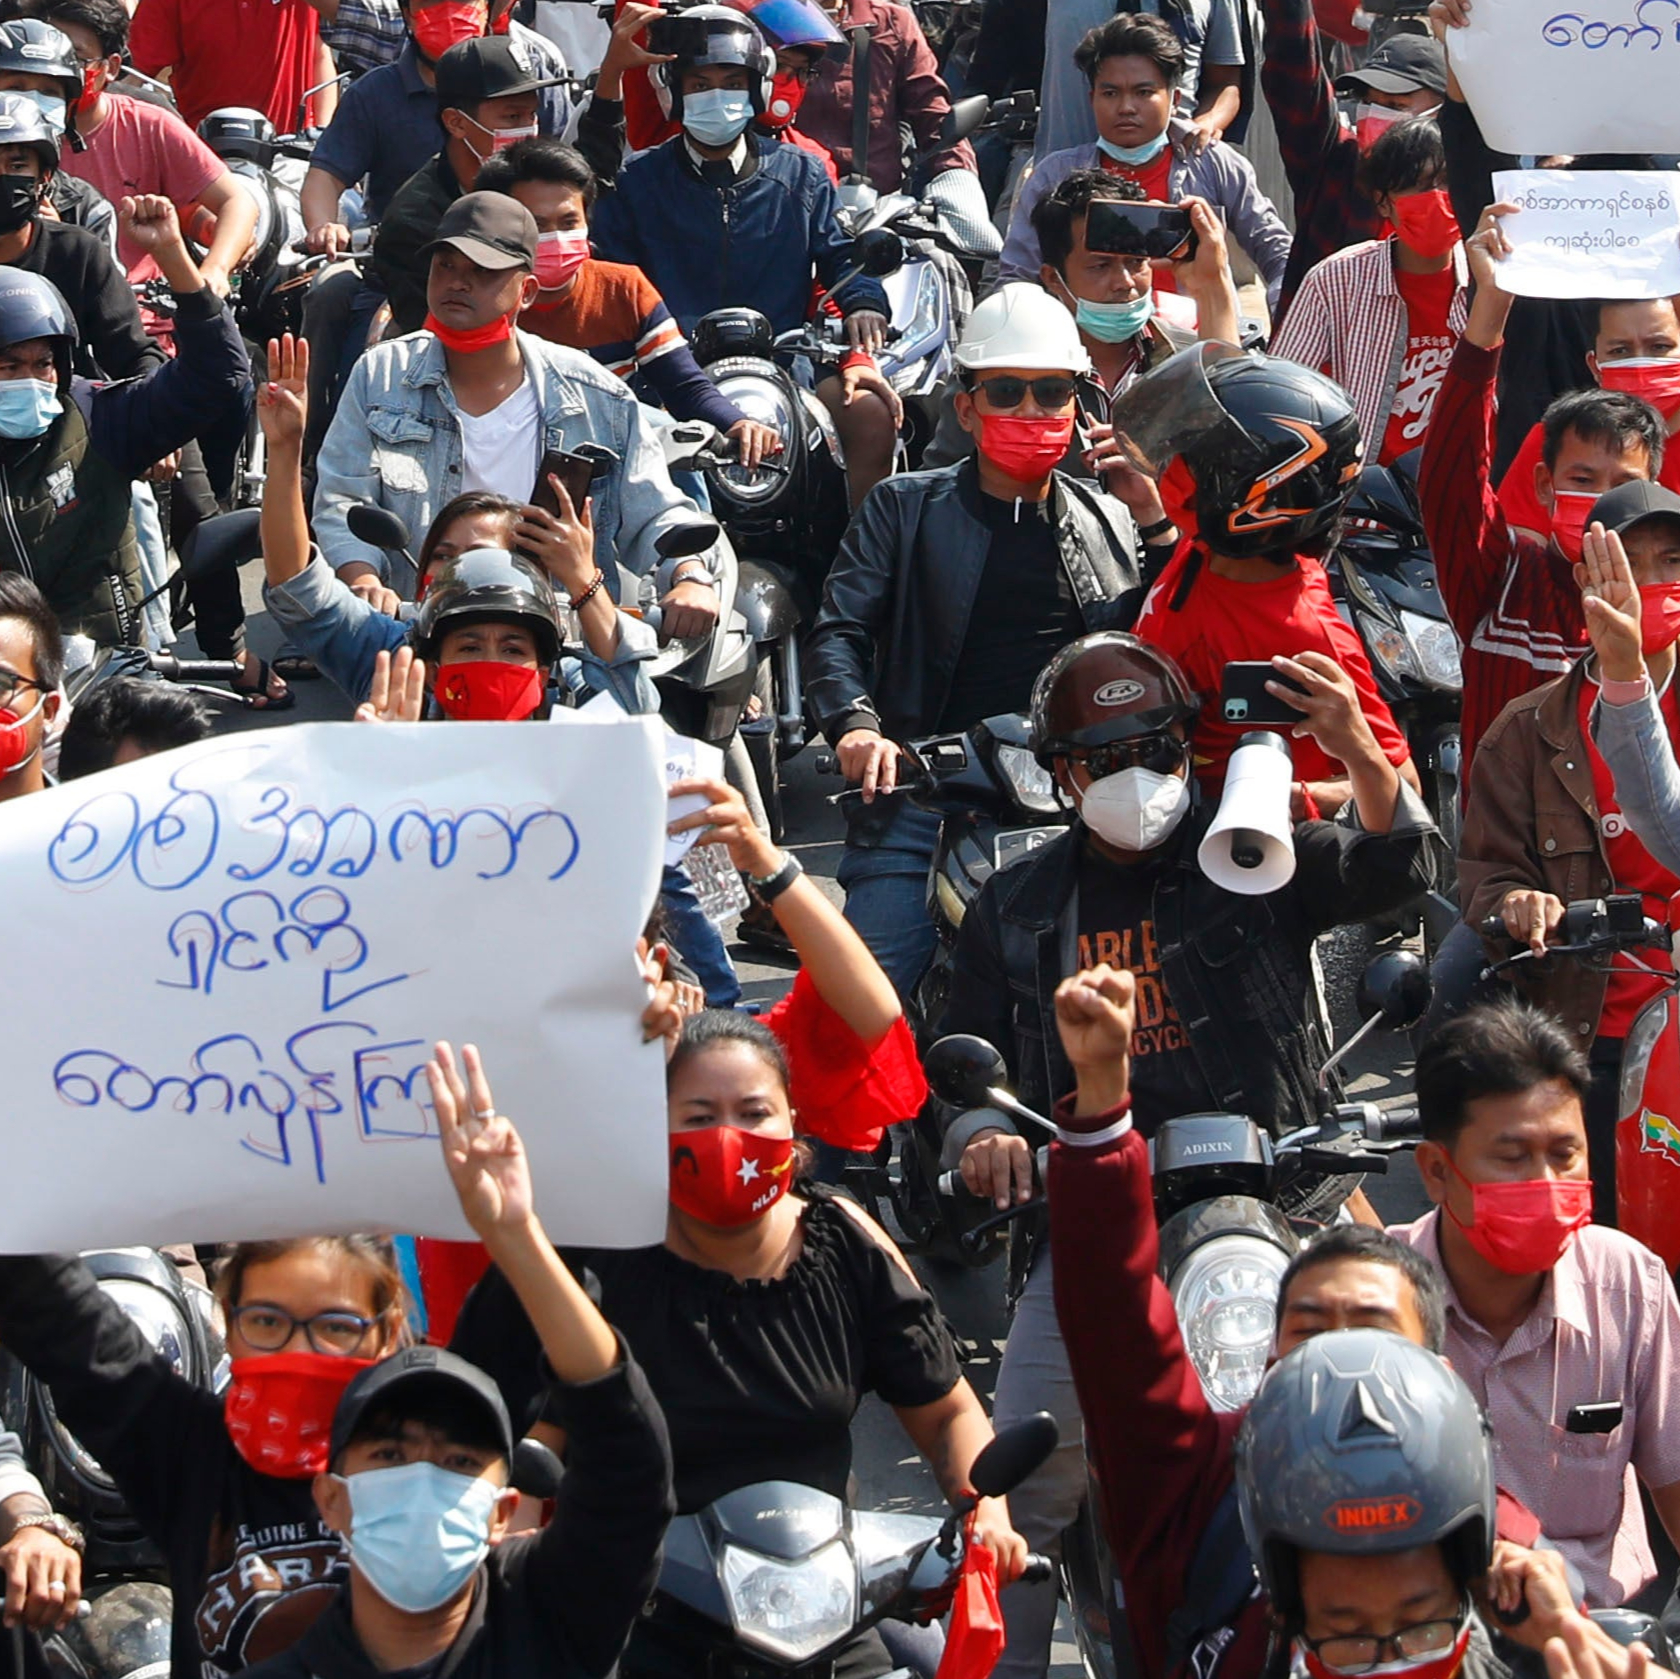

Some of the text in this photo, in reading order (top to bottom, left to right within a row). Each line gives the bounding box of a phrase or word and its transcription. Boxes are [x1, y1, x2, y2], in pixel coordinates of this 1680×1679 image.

[1543, 228, 1641, 255] ကျဆုံးပါစေ
[1182, 1141, 1233, 1156] ADIXIN
[751, 1184, 780, 1213] NLD
[1335, 1500, 1410, 1528] INDEX
